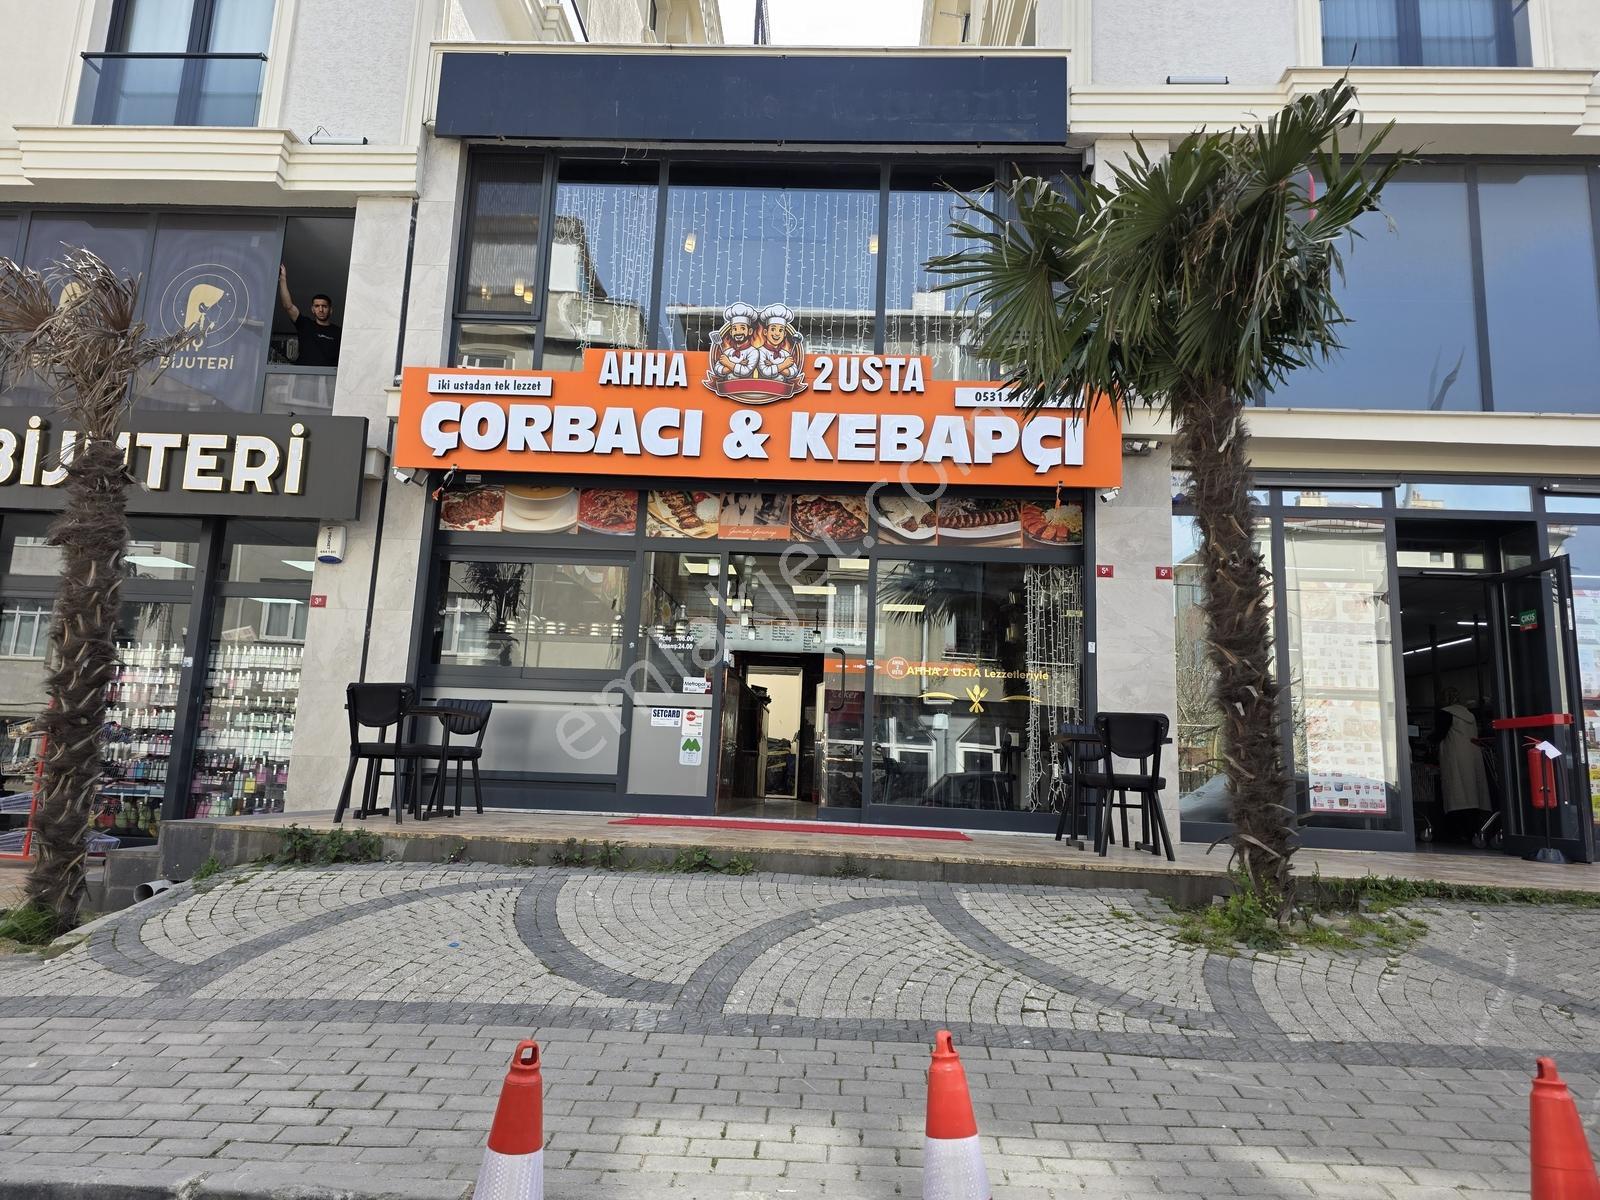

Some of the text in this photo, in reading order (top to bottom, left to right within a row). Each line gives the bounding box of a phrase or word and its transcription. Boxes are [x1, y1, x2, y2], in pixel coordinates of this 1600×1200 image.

[160, 354, 234, 370] BİJUTERİ
[599, 351, 687, 387] AHHA
[437, 379, 541, 392] iki ustadan tek lezzet
[975, 391, 1002, 402] 0531
[421, 401, 1085, 473] ÇORBACI & KEBAPÇI
[0, 416, 305, 493] İJTERİ
[906, 666, 1049, 682] AHHA 2 USTA Lezzetleriyle
[652, 709, 680, 718] SETCARD
